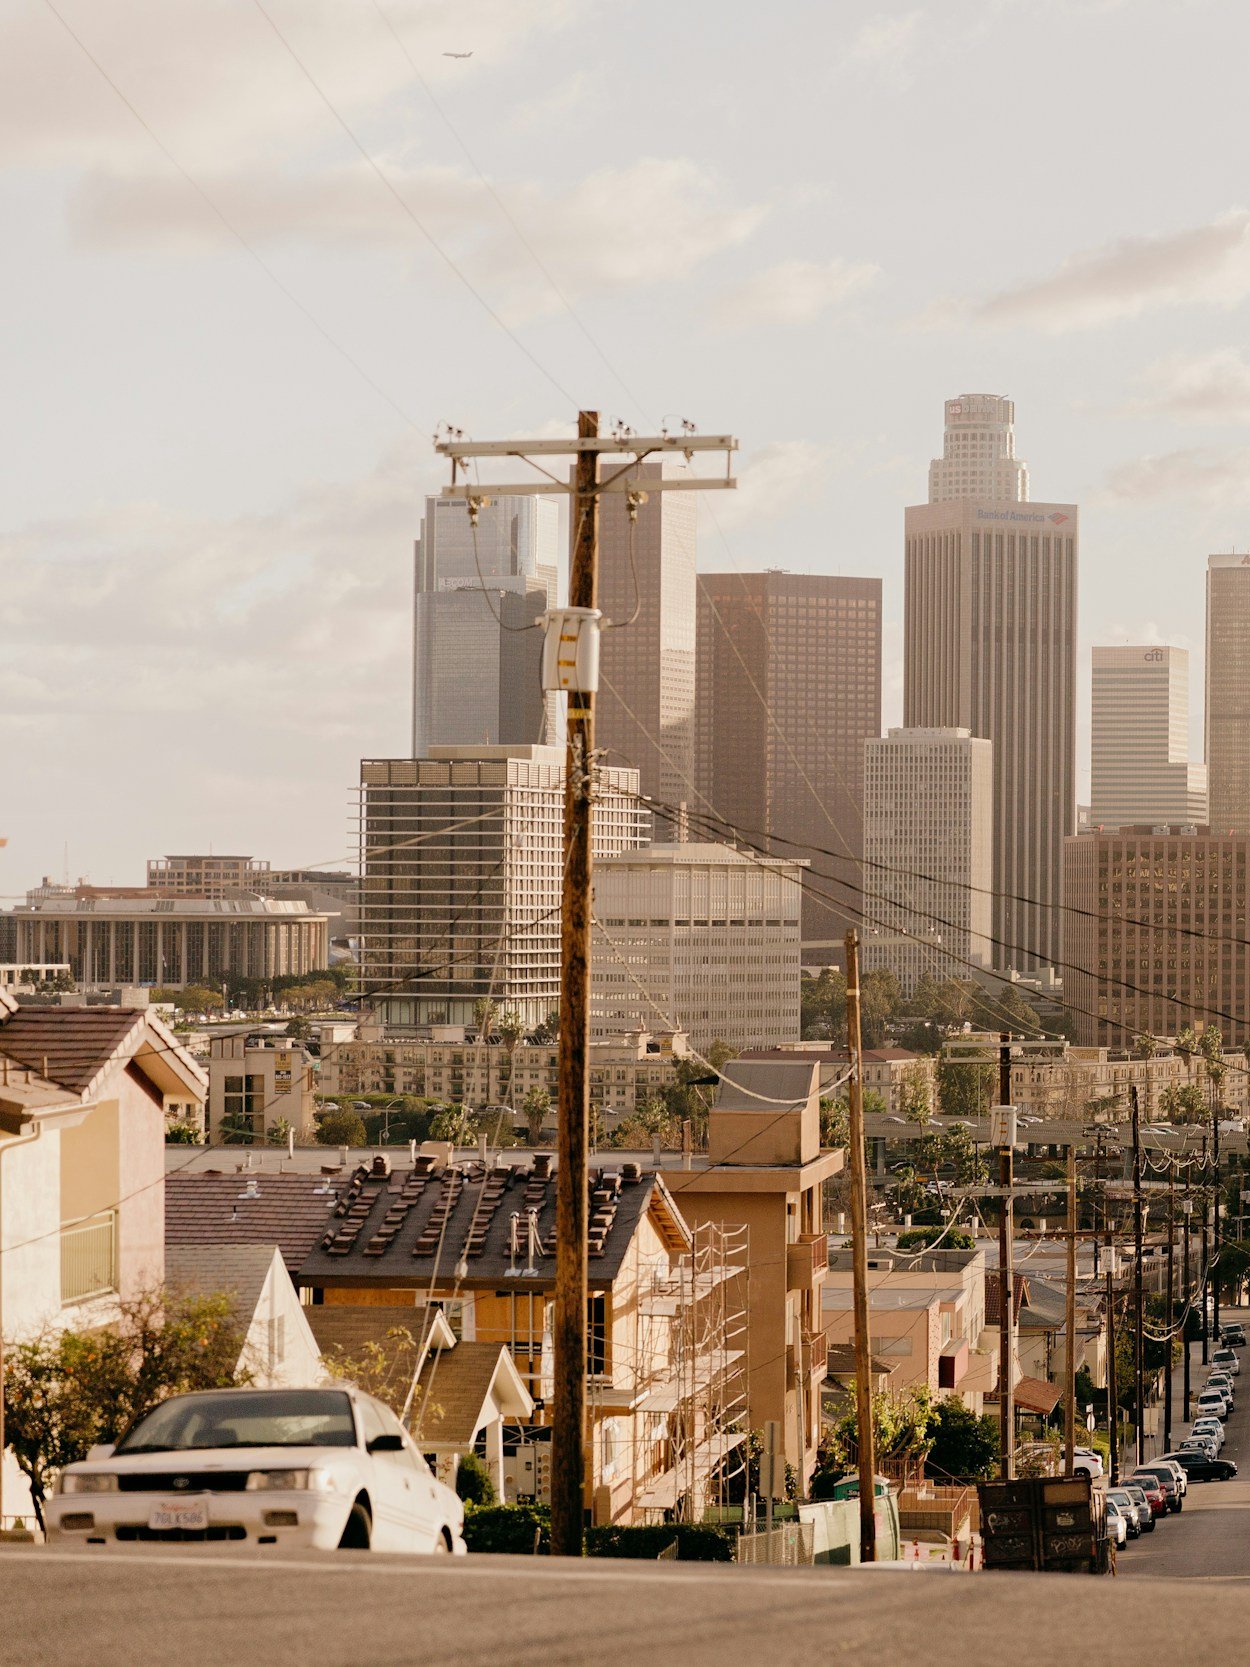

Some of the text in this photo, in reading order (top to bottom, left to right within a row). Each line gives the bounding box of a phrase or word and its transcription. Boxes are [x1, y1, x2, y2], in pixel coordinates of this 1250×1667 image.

[977, 509, 1045, 522] Bank of America
[1144, 649, 1163, 661] citi
